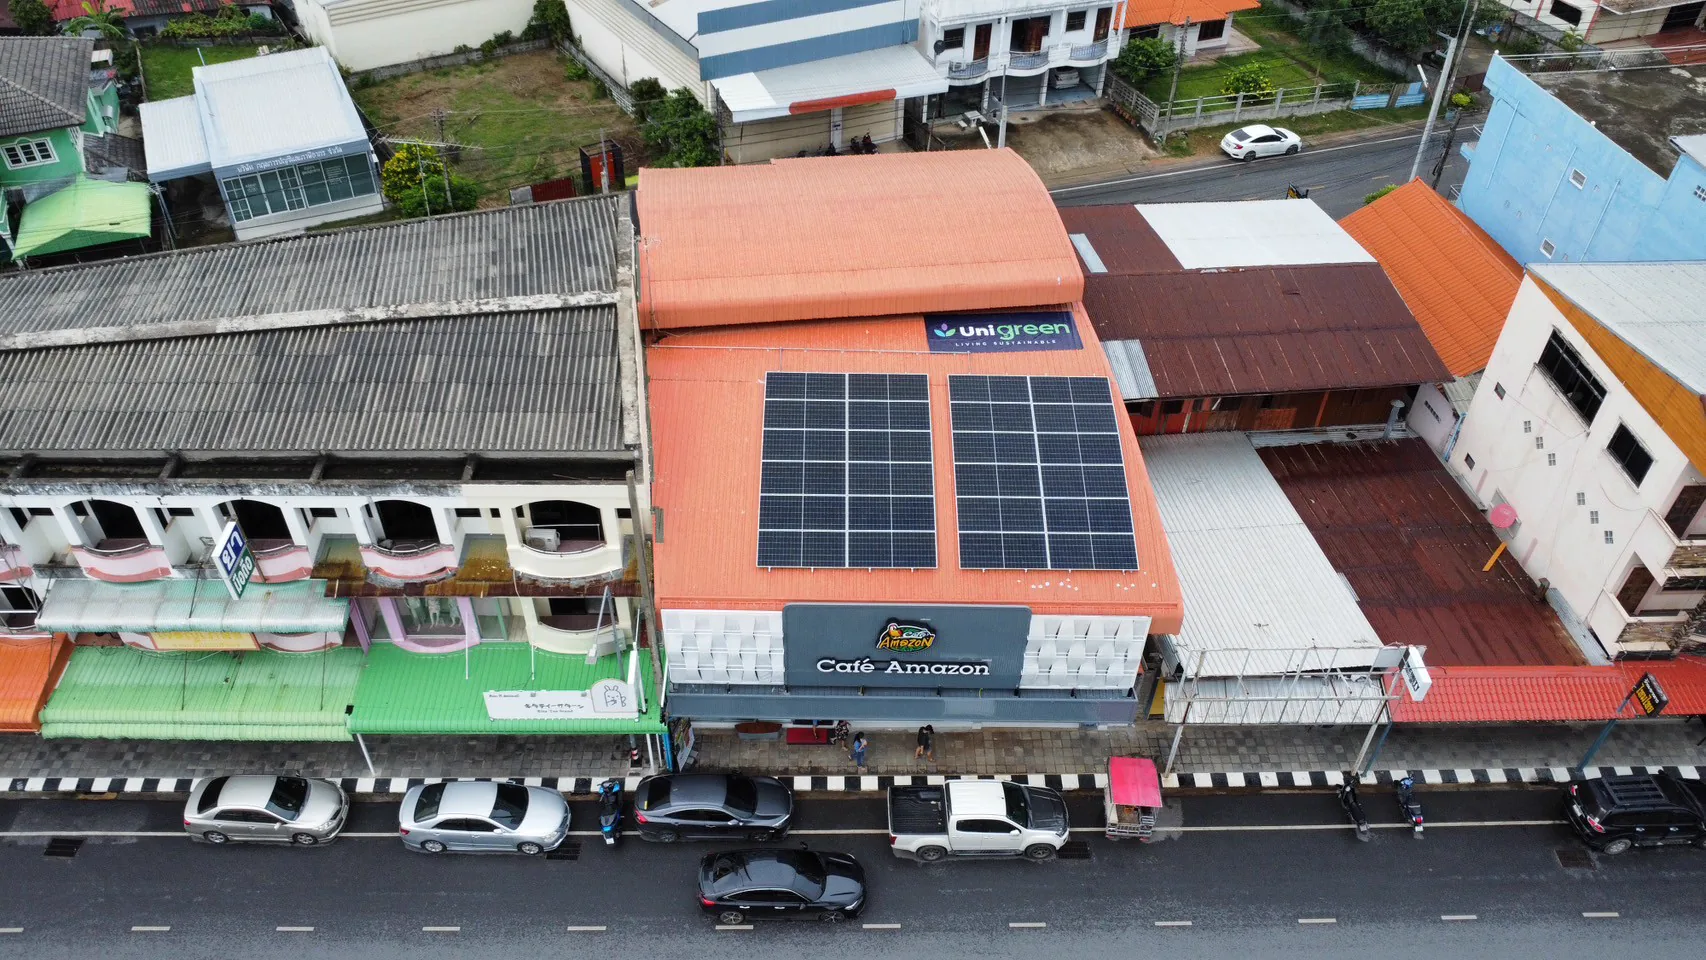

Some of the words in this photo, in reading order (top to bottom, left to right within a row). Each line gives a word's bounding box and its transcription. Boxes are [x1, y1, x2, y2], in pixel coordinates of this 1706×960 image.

[222, 531, 244, 571] ยา
[816, 658, 875, 674] Café
[885, 660, 990, 676] Amazon
